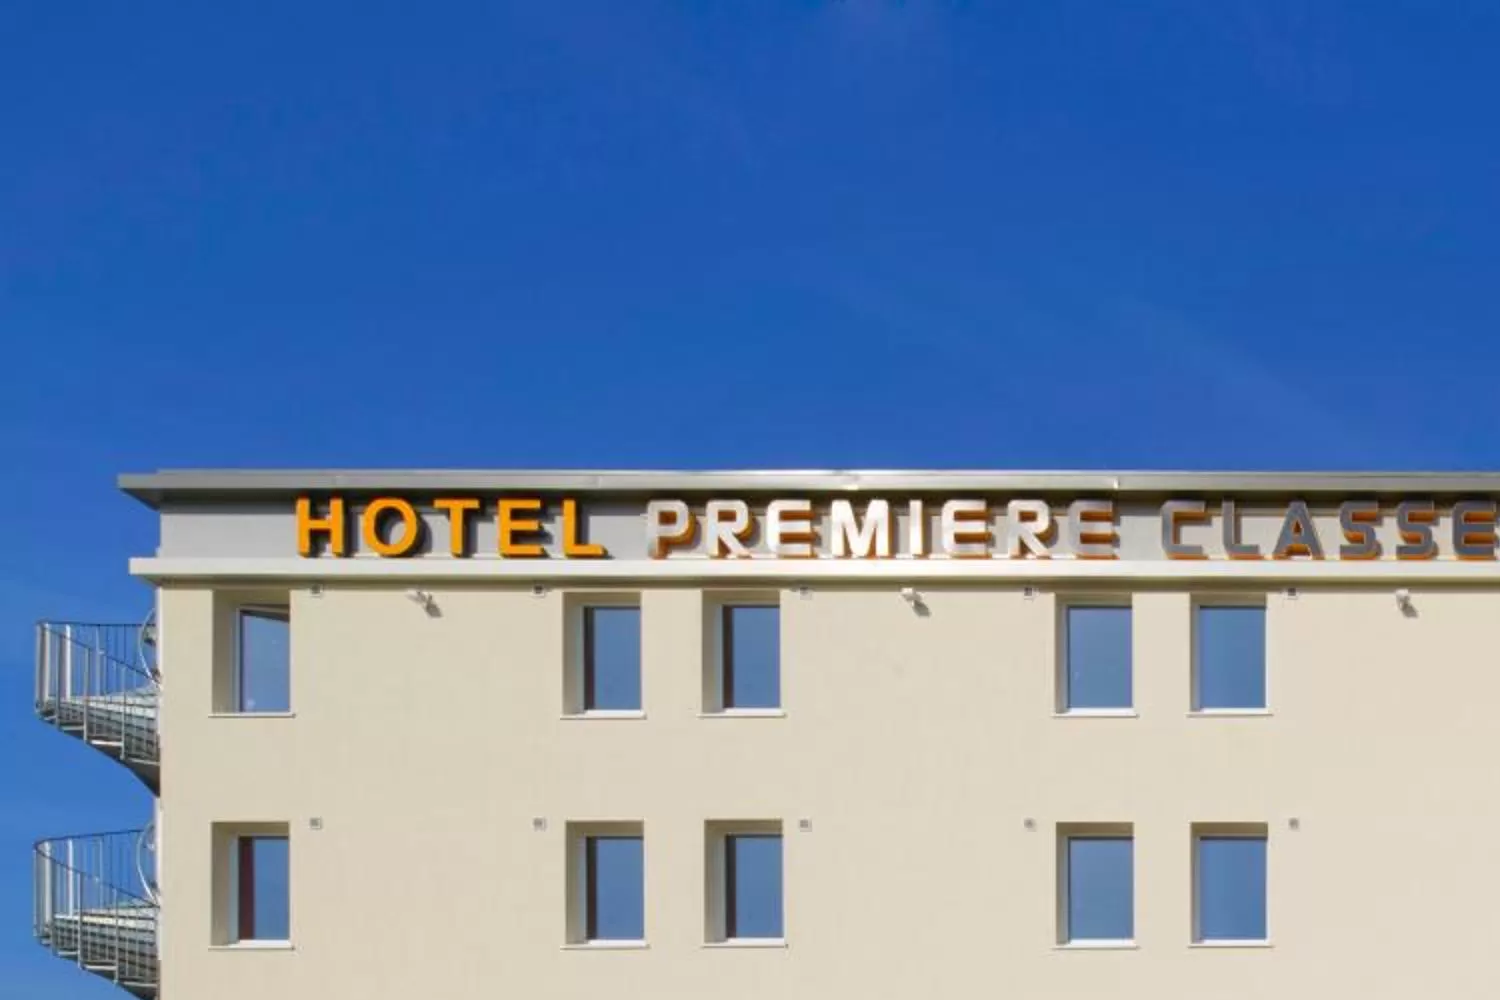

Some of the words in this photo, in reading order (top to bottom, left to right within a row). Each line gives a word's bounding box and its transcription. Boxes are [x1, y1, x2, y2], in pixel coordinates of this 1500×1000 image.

[295, 497, 606, 559] HOTEL
[647, 498, 1119, 560] PREMIERE
[1160, 498, 1498, 561] CLASSE
